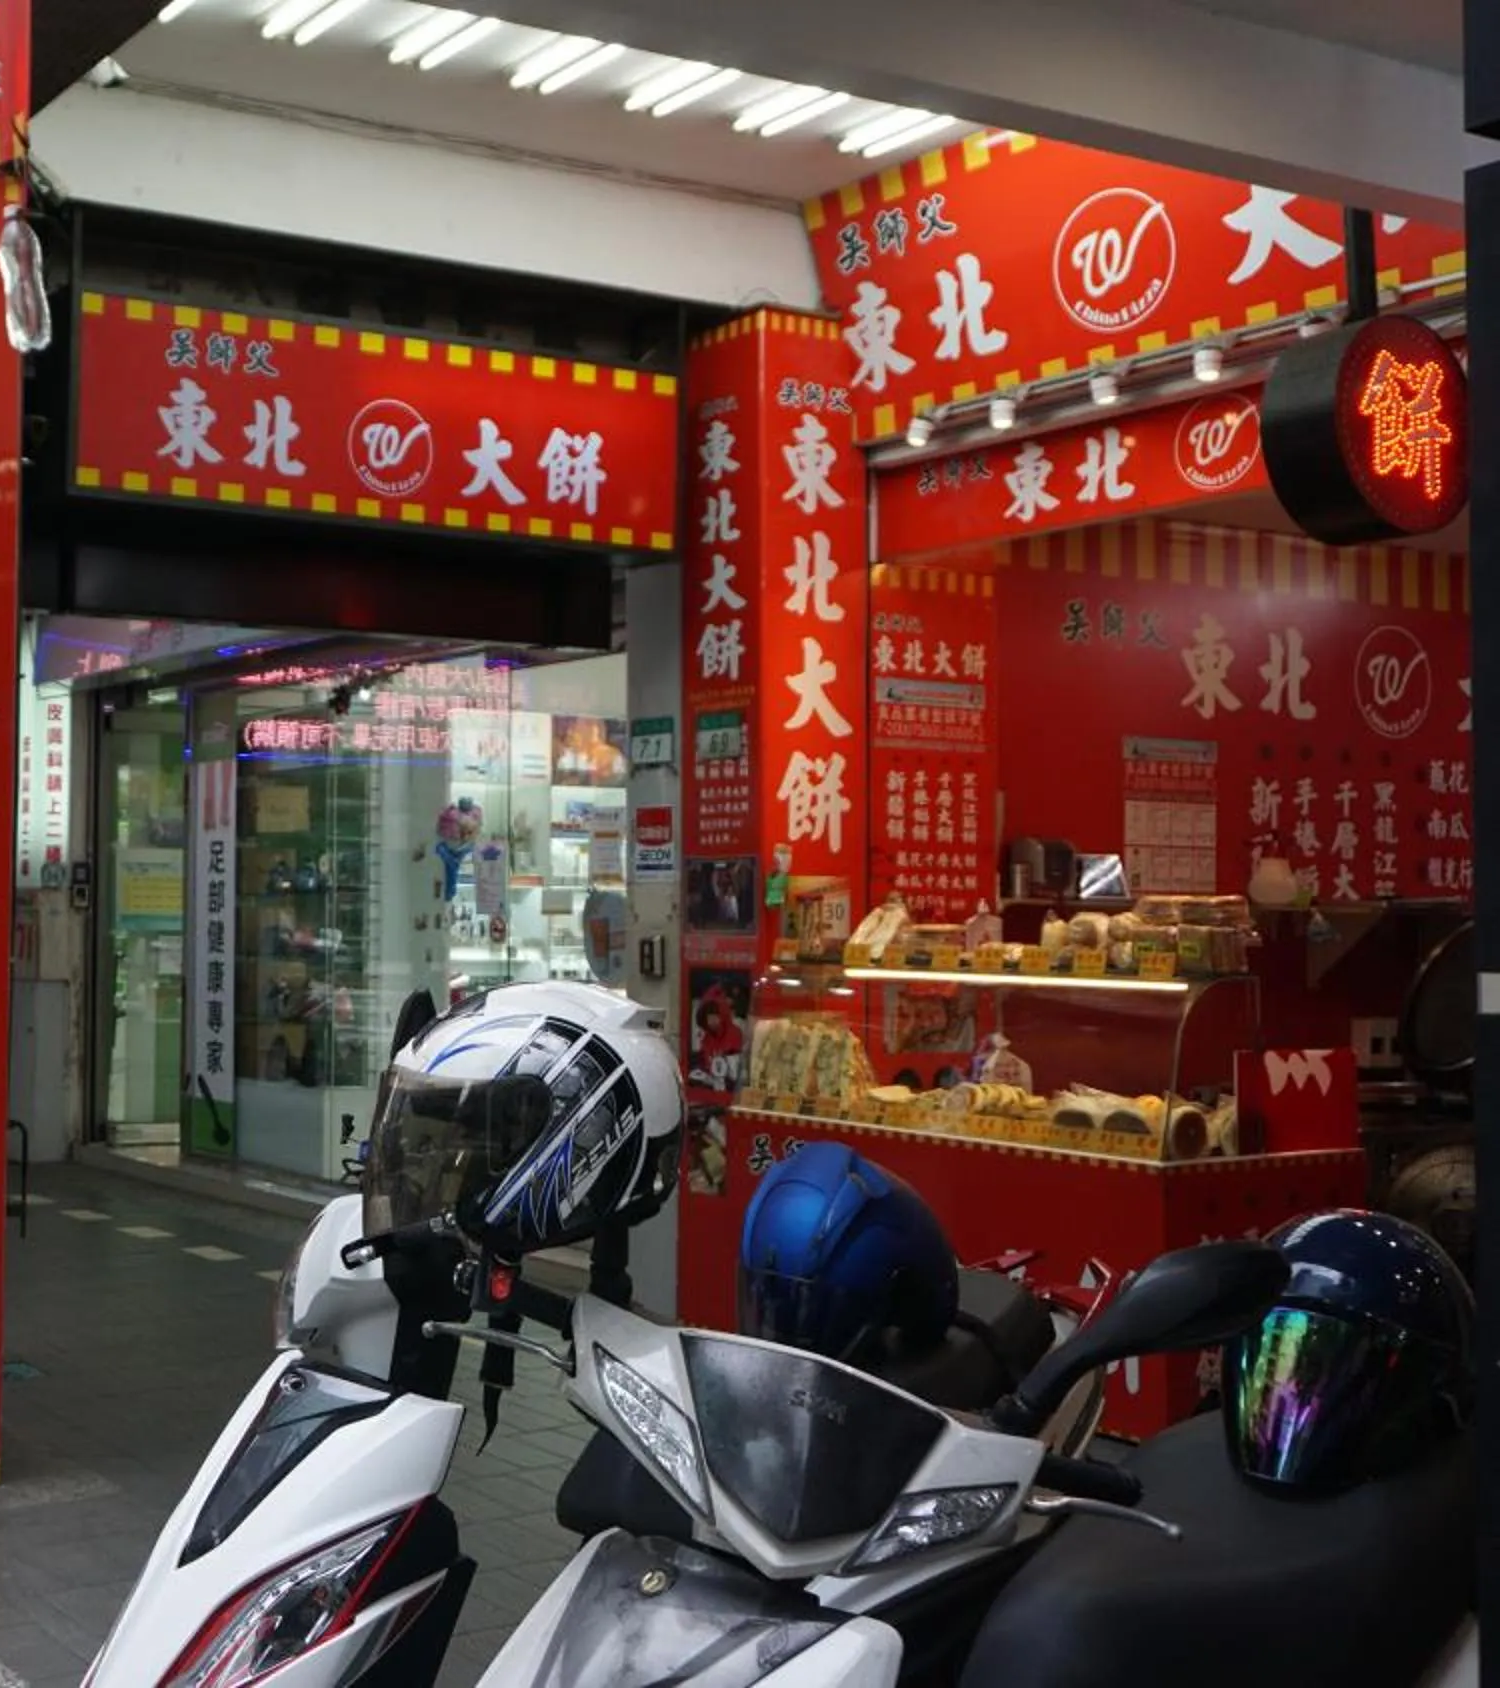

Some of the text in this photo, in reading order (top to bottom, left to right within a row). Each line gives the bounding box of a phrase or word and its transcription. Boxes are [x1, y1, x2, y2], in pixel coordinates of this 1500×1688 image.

[835, 193, 957, 275] 吳師父
[843, 185, 1408, 392] 東北 大
[165, 328, 280, 377] 吳師父
[777, 377, 853, 414] 吳師父
[156, 377, 607, 516] 東北 大餅
[1003, 426, 1136, 523] 東北
[1360, 349, 1452, 500] 餅
[696, 420, 747, 681] 東北大餅
[776, 413, 853, 854] 東北大餅
[871, 634, 987, 681] 東北大餅
[1180, 613, 1317, 721] 東北
